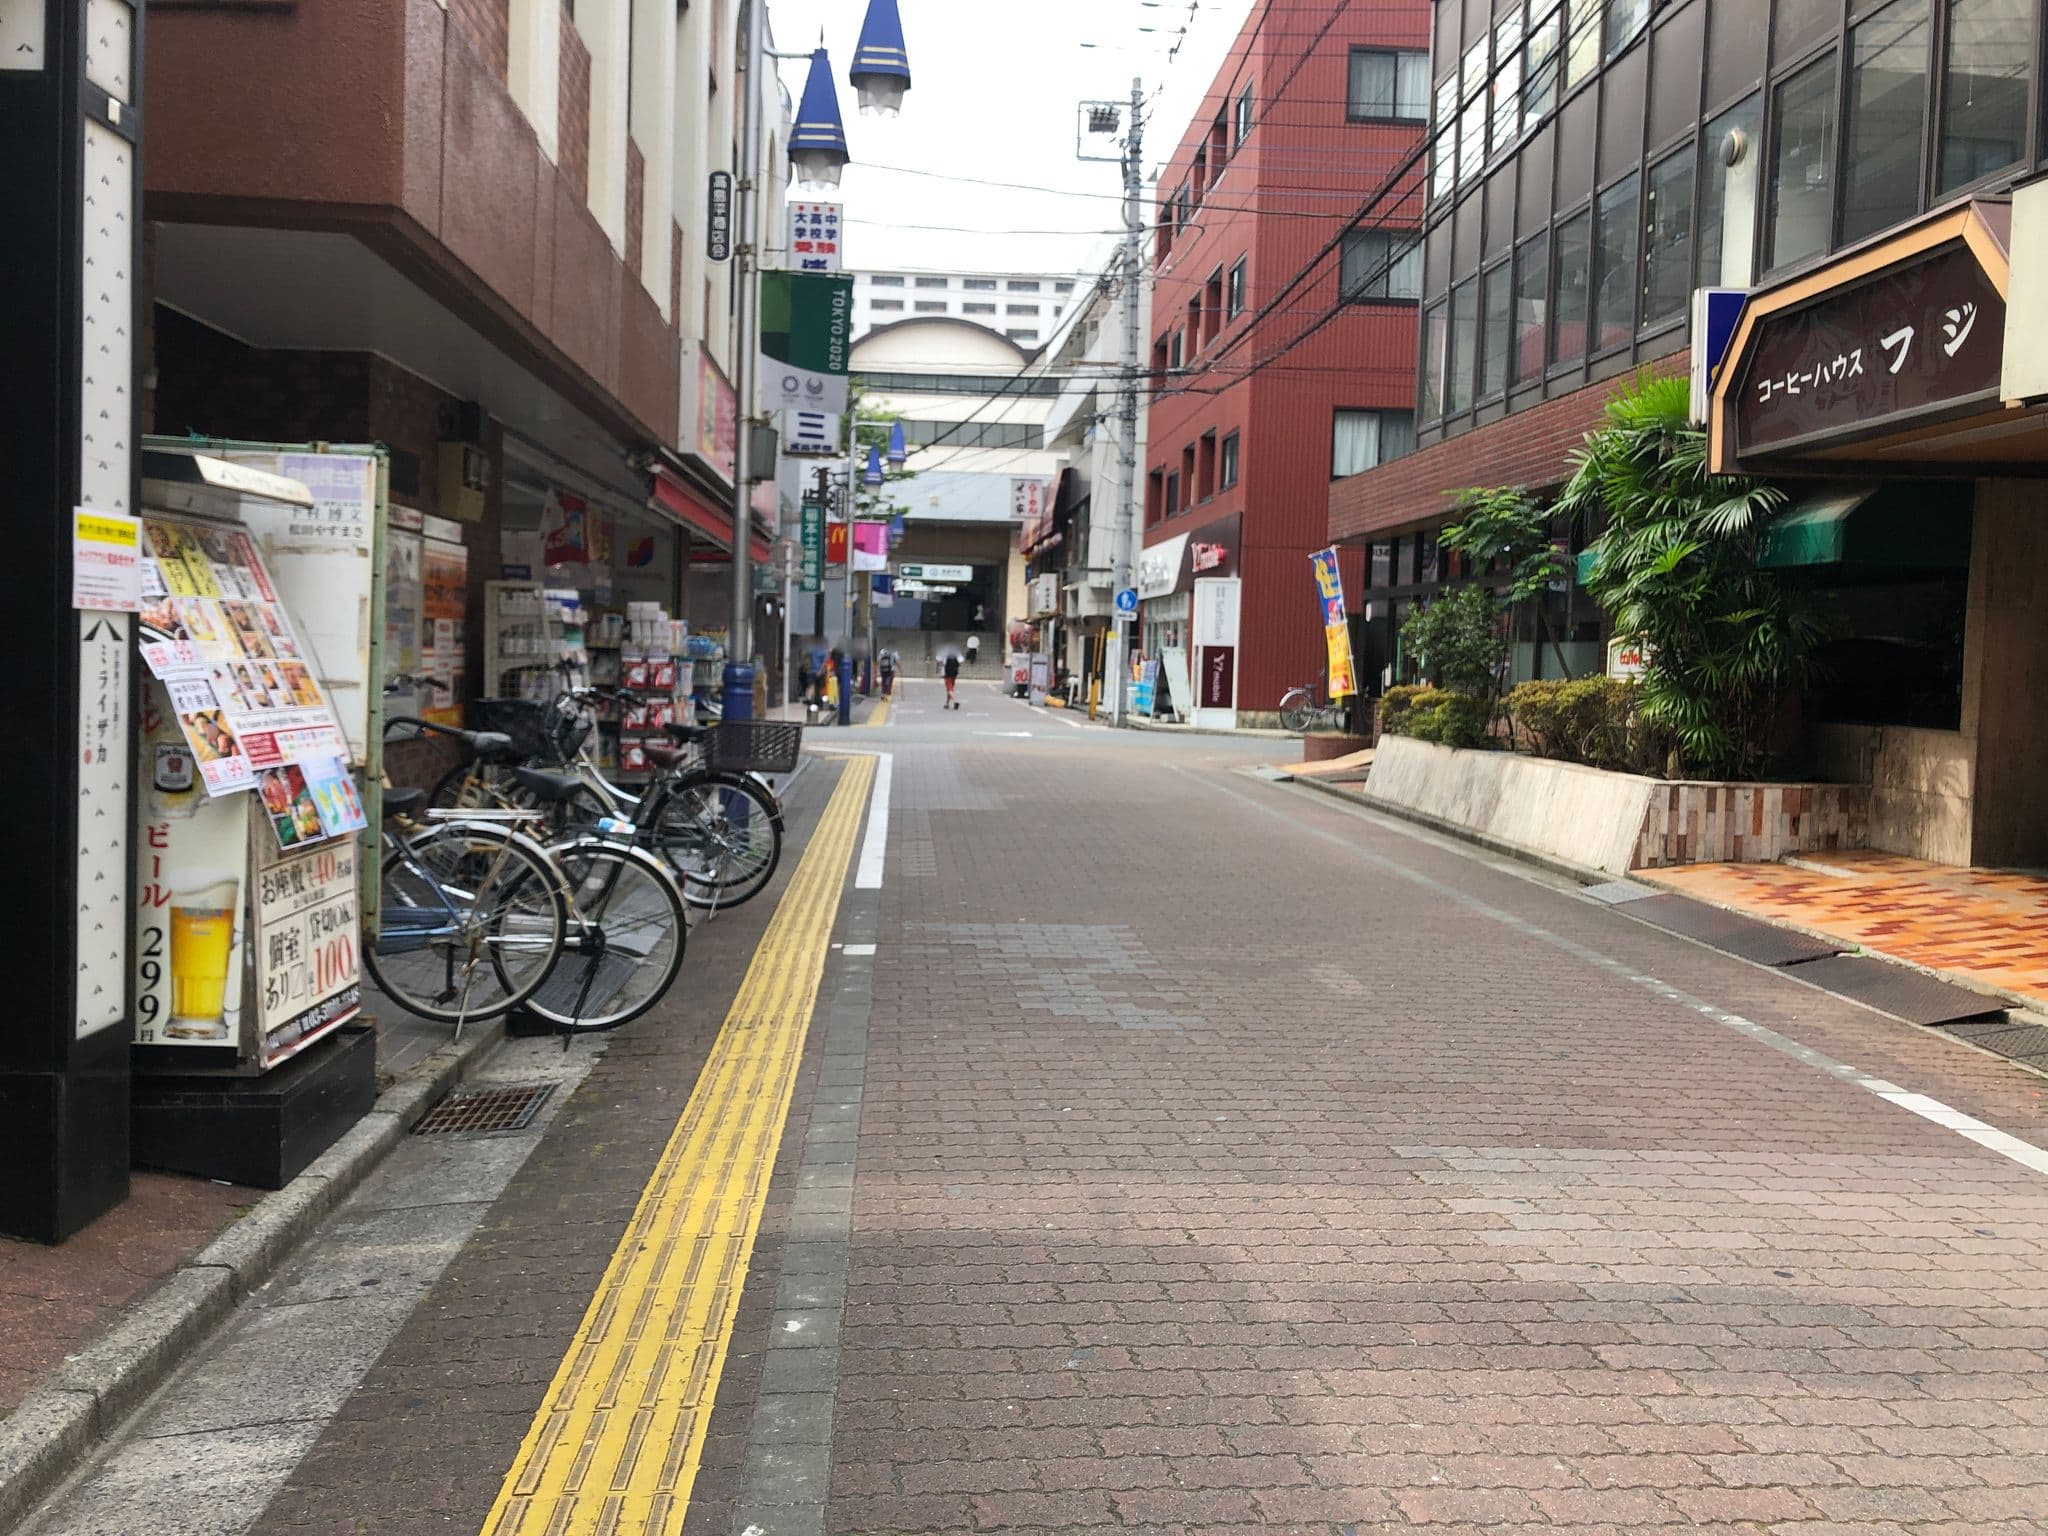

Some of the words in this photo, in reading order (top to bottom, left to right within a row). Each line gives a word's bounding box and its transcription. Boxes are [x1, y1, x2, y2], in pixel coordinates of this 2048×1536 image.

[795, 241, 836, 254] 受験
[832, 288, 845, 335] TOKYO
[828, 337, 844, 371] 2020
[1758, 348, 1864, 403] コーヒーハウス
[1881, 302, 1977, 375] フジ
[139, 823, 173, 909] ビール
[270, 926, 300, 970] 個室
